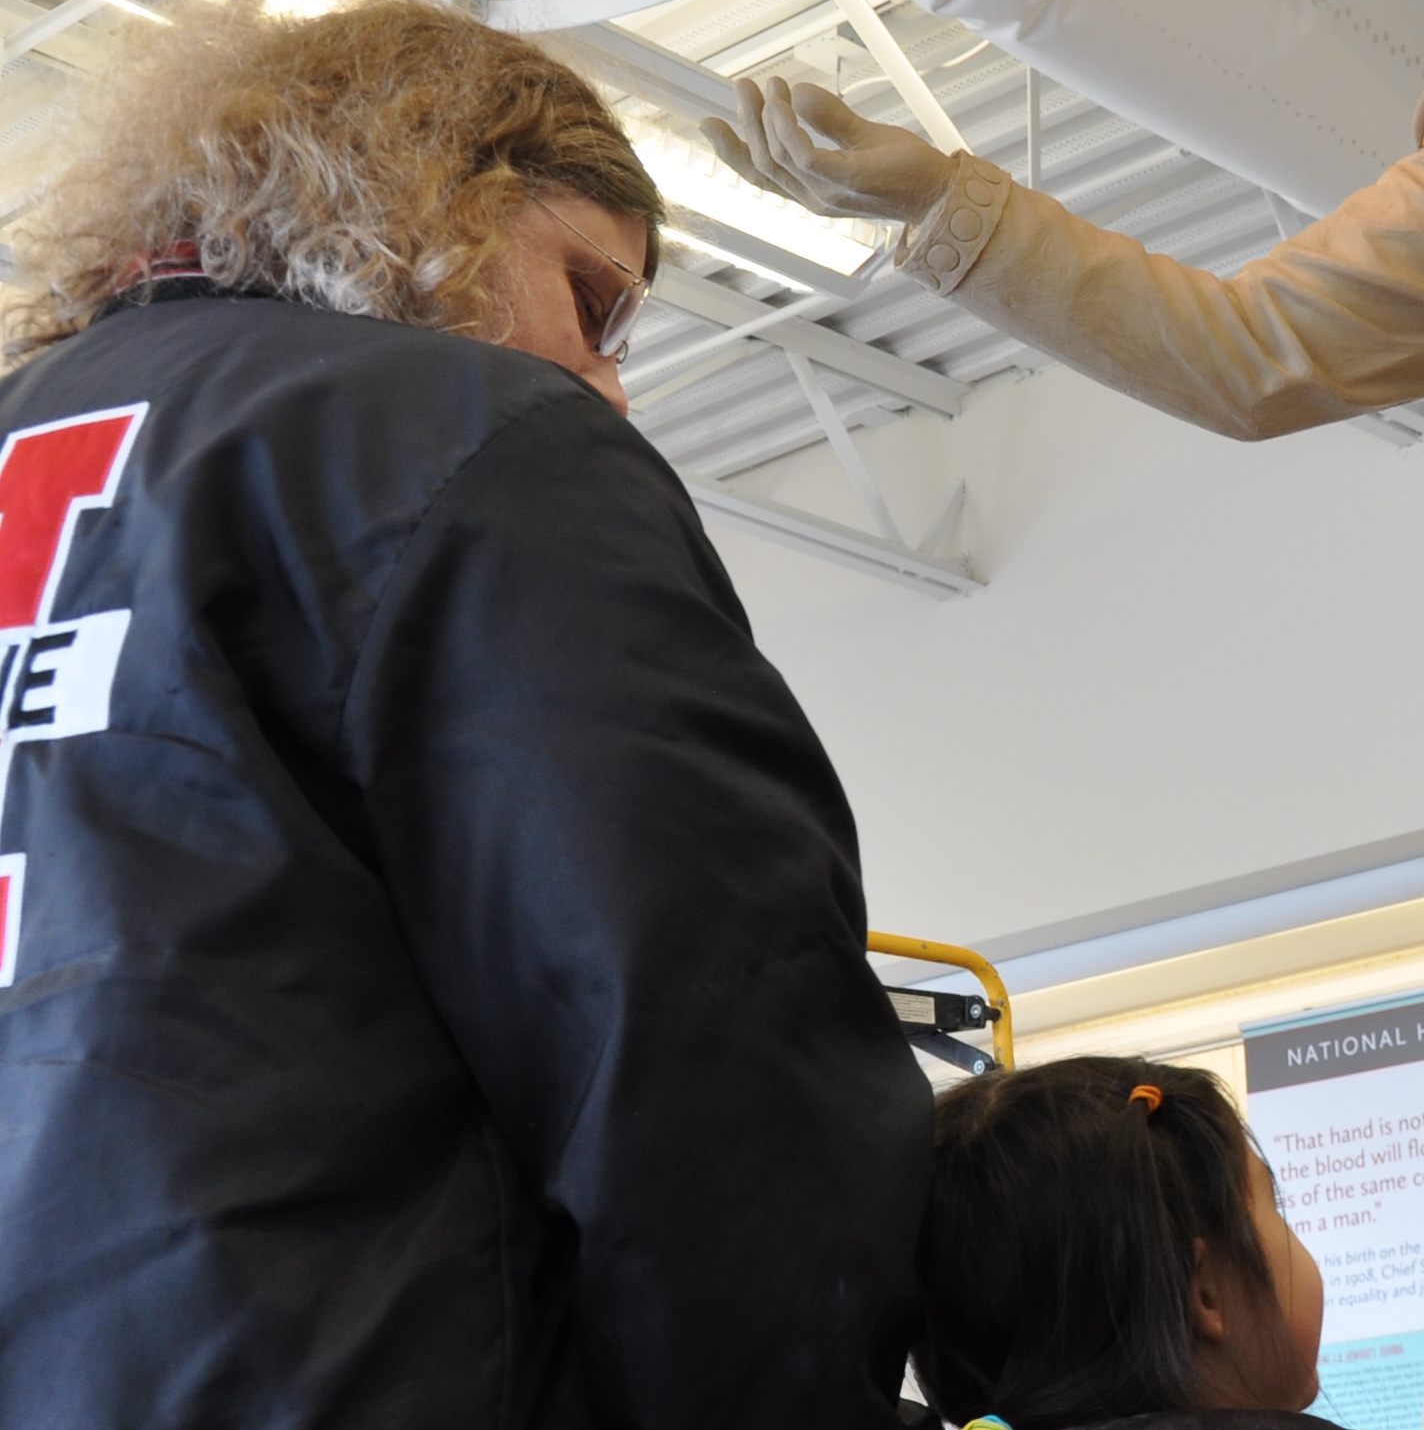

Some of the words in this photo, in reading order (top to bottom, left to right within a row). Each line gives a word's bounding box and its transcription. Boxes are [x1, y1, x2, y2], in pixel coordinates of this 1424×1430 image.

[1286, 1027, 1407, 1067] NATIONAL
[1273, 1132, 1324, 1153] “That
[1329, 1119, 1374, 1145] hand
[1379, 1117, 1393, 1136] is
[1279, 1161, 1309, 1182] the
[1315, 1149, 1366, 1177] blood
[1371, 1142, 1403, 1166] will
[1301, 1183, 1321, 1206] of
[1325, 1181, 1355, 1203] the
[1360, 1173, 1407, 1196] same
[1317, 1217, 1327, 1232] a
[1324, 1253, 1342, 1268] his
[1345, 1247, 1376, 1266] birth
[1379, 1247, 1396, 1260] on
[1400, 1240, 1421, 1256] the
[1329, 1273, 1341, 1287] in
[1345, 1267, 1378, 1288] 1908,
[1381, 1259, 1419, 1280] Chief
[1338, 1286, 1389, 1308] equality
[1392, 1280, 1416, 1298] and
